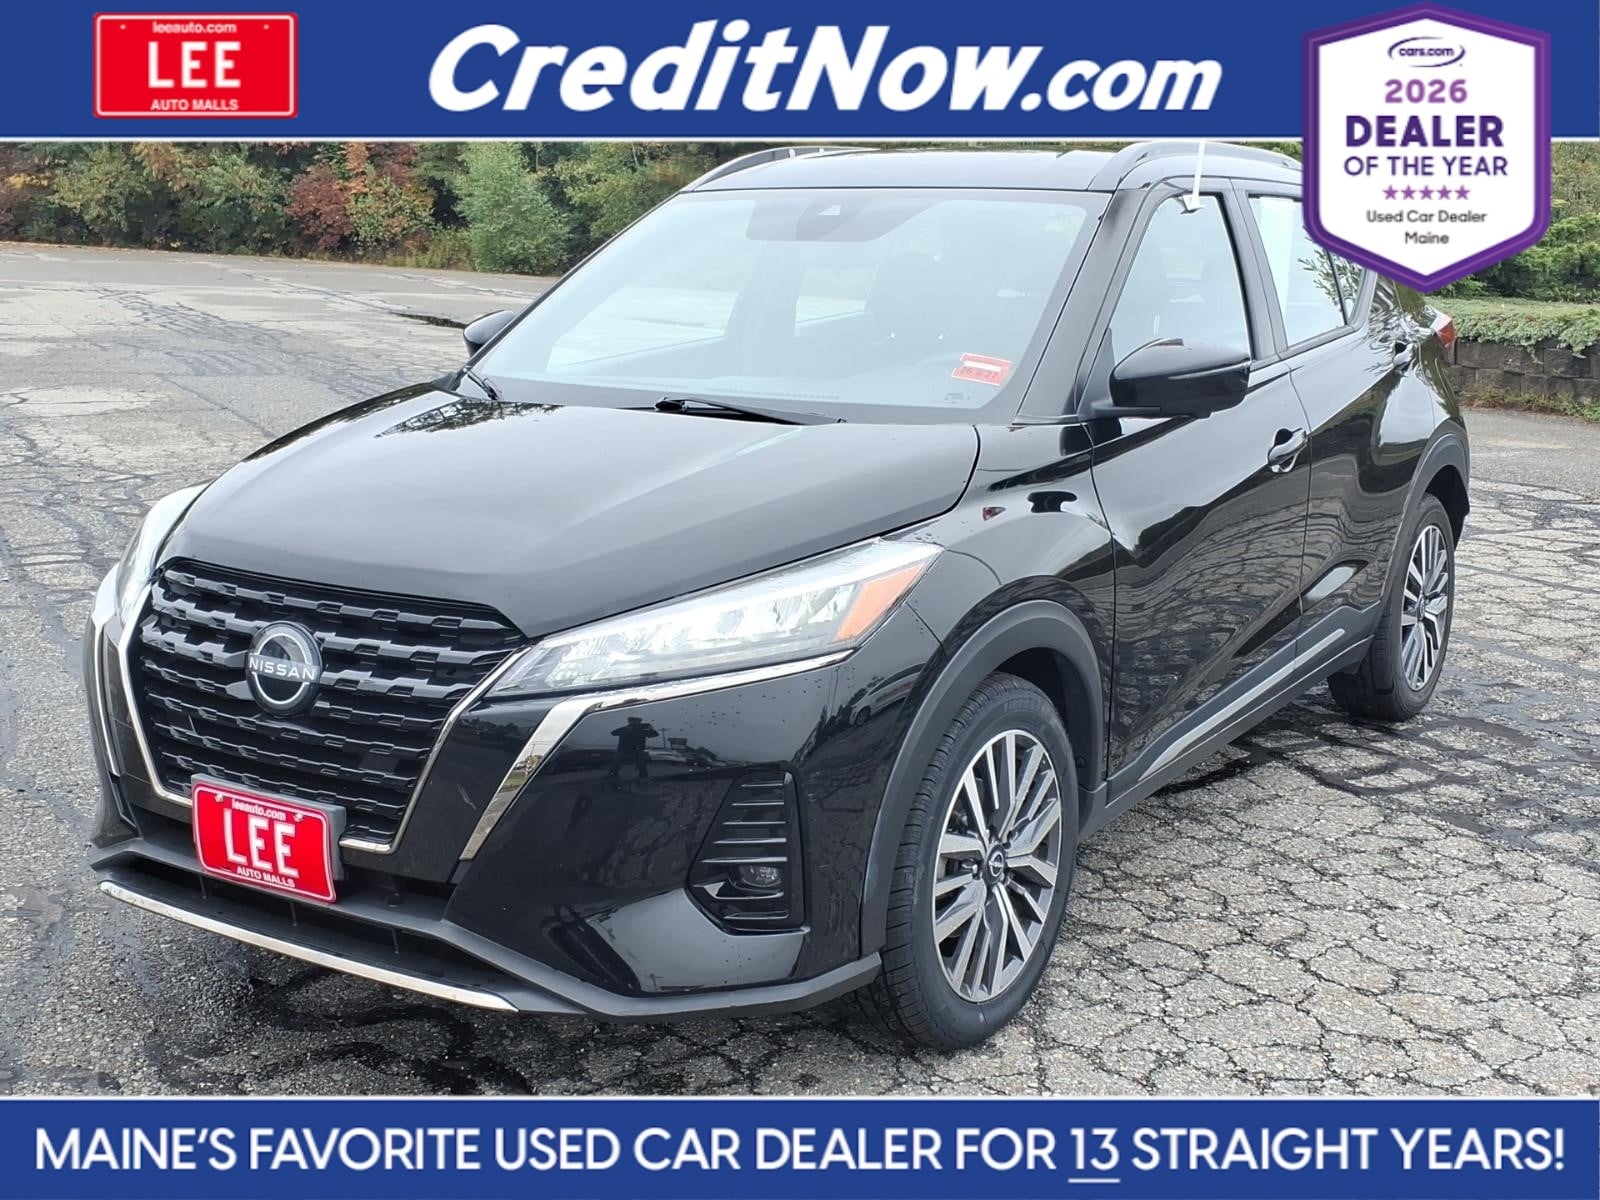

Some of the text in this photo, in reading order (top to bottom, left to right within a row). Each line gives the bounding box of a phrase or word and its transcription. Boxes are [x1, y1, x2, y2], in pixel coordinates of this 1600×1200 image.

[249, 656, 316, 680] NISSAN
[232, 798, 287, 822] leeauto.com
[224, 807, 299, 879] LEE
[236, 865, 296, 889] AUTO MALLS
